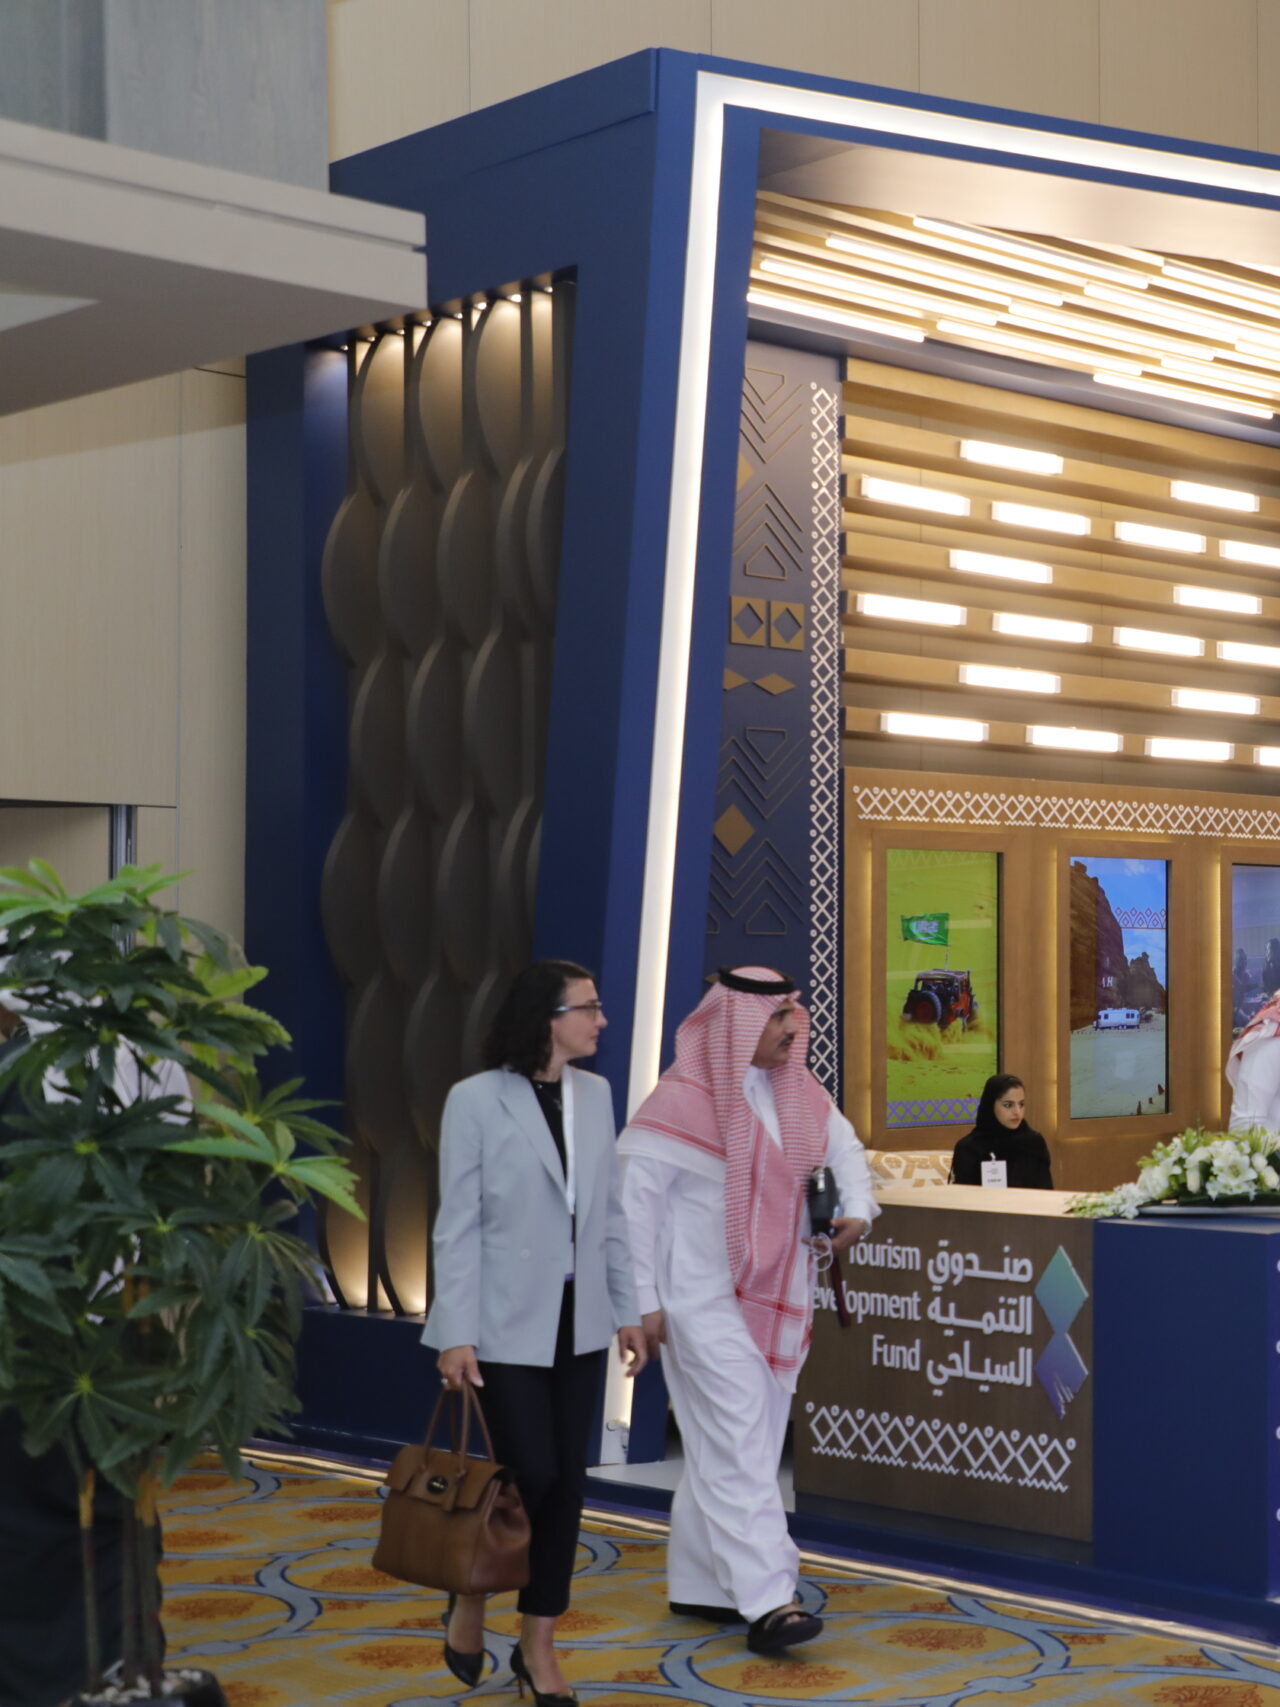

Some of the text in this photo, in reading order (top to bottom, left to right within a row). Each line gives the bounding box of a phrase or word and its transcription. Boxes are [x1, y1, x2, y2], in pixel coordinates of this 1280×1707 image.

[927, 1240, 1033, 1286] صندوق
[927, 1284, 1033, 1336] التنمية
[872, 1334, 921, 1372] Fund
[926, 1340, 1033, 1396] السياحي
